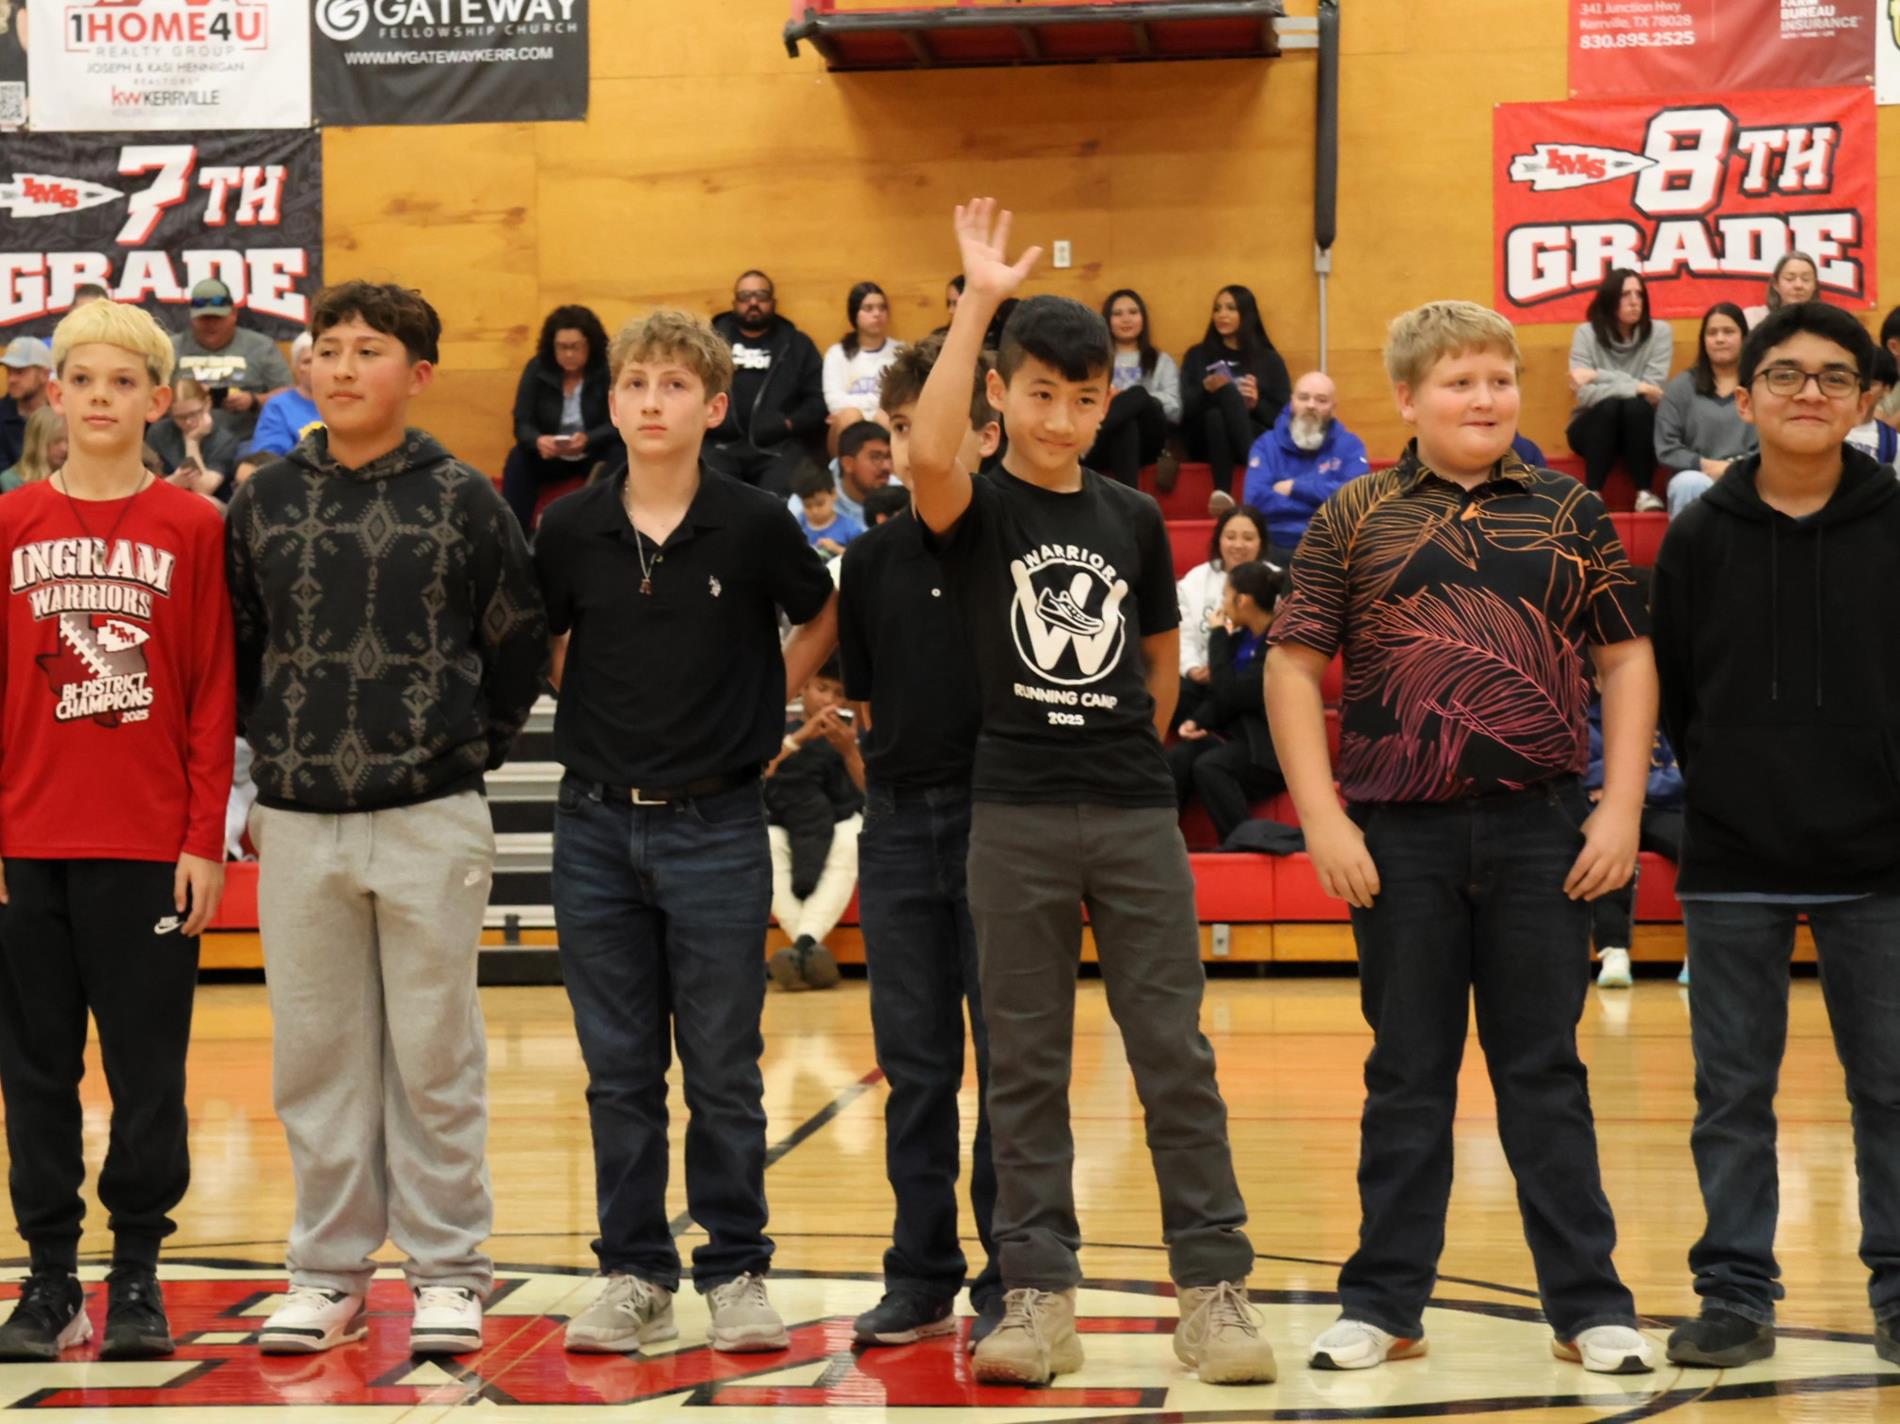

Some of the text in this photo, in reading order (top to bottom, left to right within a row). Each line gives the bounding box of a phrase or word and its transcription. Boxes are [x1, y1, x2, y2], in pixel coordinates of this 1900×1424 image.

[373, 0, 577, 26] GATEWAY
[1654, 1, 1681, 12] Hwy
[1781, 5, 1835, 19] BUREAU
[70, 11, 261, 43] 1HOME4U
[378, 22, 579, 39] FELLOWSHIP CHURCH
[1632, 16, 1649, 27] TX
[96, 45, 235, 58] REALTY GROUP
[1579, 31, 1697, 49] 830.895.2525
[86, 63, 132, 74] JOSEPH
[136, 62, 144, 73] &
[344, 46, 554, 66] WWW.MYGATEWAYKERR.COM
[1632, 106, 1840, 218] 8TH
[115, 144, 288, 247] 7TH
[1505, 210, 1861, 304] GRADE
[0, 247, 314, 327] GRADE
[10, 536, 175, 598] INGRAM
[1023, 543, 1117, 582] WARRIOR
[29, 583, 153, 622] WARRIORS
[62, 672, 148, 701] BI-DISTRICT
[1013, 682, 1118, 710] RUNNING CAMP
[56, 687, 154, 719] CHAMPIONS
[121, 708, 150, 723] 2025
[1047, 711, 1085, 726] 2025
